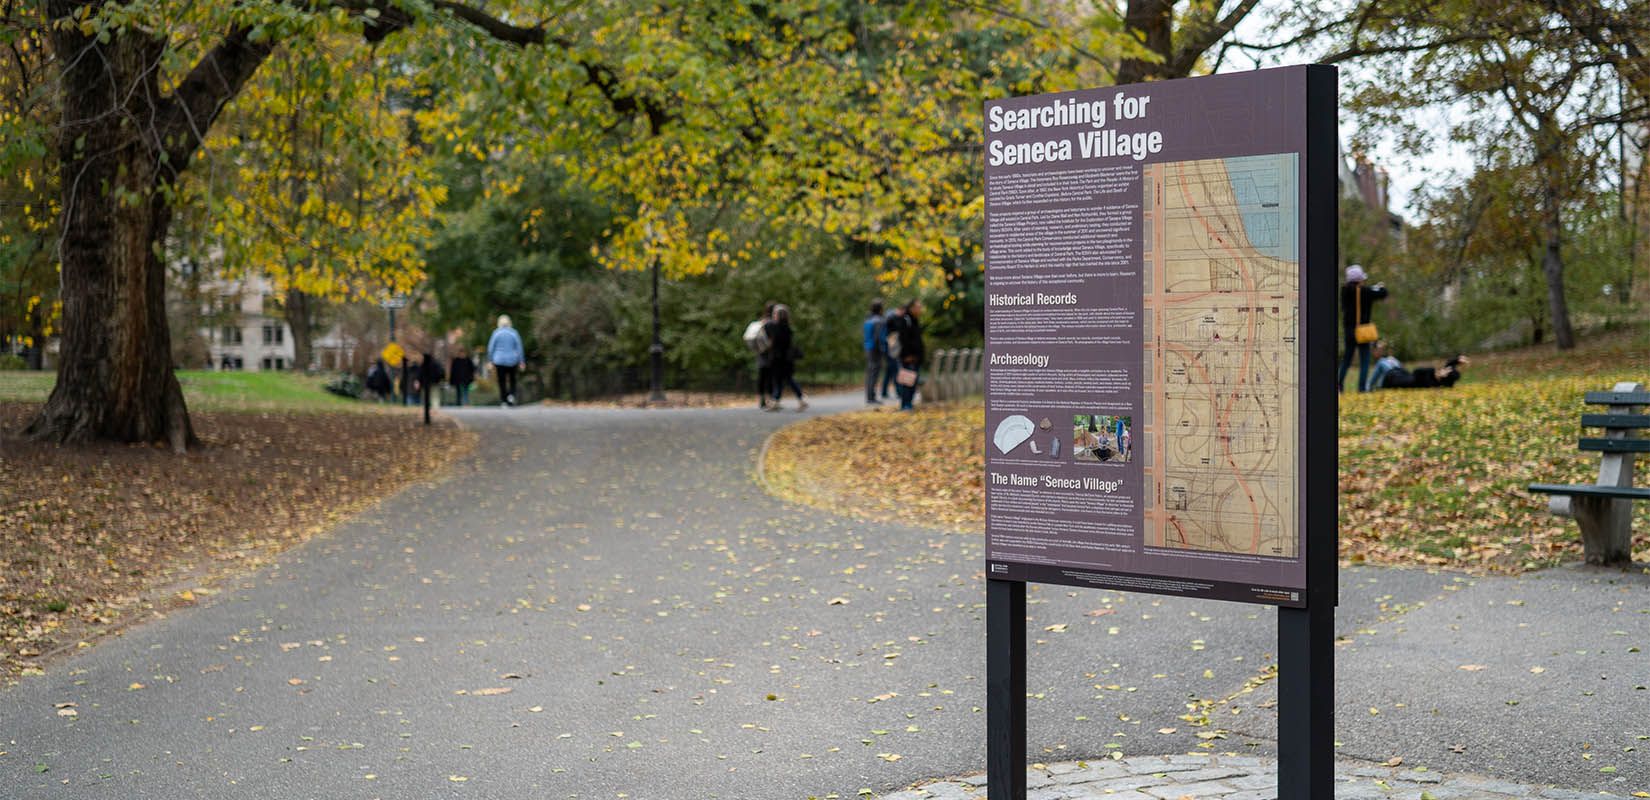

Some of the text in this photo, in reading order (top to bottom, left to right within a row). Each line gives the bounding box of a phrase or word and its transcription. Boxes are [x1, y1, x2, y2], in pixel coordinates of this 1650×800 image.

[989, 92, 1151, 133] Searching for
[989, 129, 1163, 166] Seneca Village
[989, 291, 1078, 306] Historical Records
[990, 353, 1050, 369] Archaeology
[991, 472, 1123, 493] The Name “Seneca Village”
